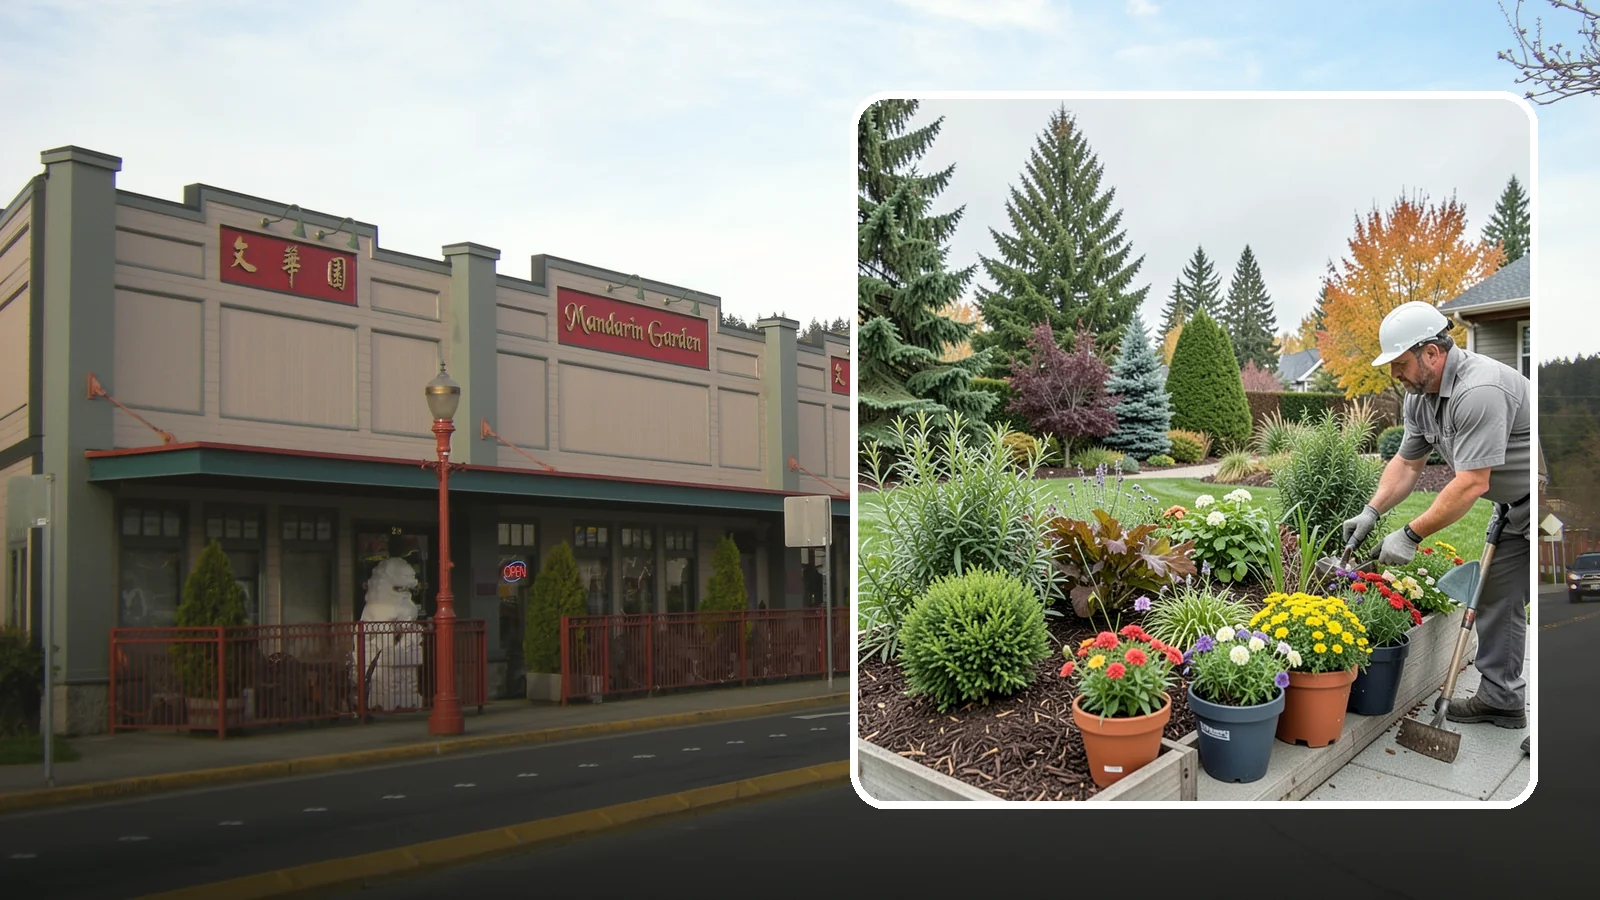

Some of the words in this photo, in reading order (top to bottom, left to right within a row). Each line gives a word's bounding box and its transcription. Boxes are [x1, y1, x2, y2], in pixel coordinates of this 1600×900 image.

[230, 235, 346, 291] 文華園
[564, 302, 644, 341] Mandarin
[648, 320, 702, 352] Garden
[503, 565, 527, 578] OPEN
